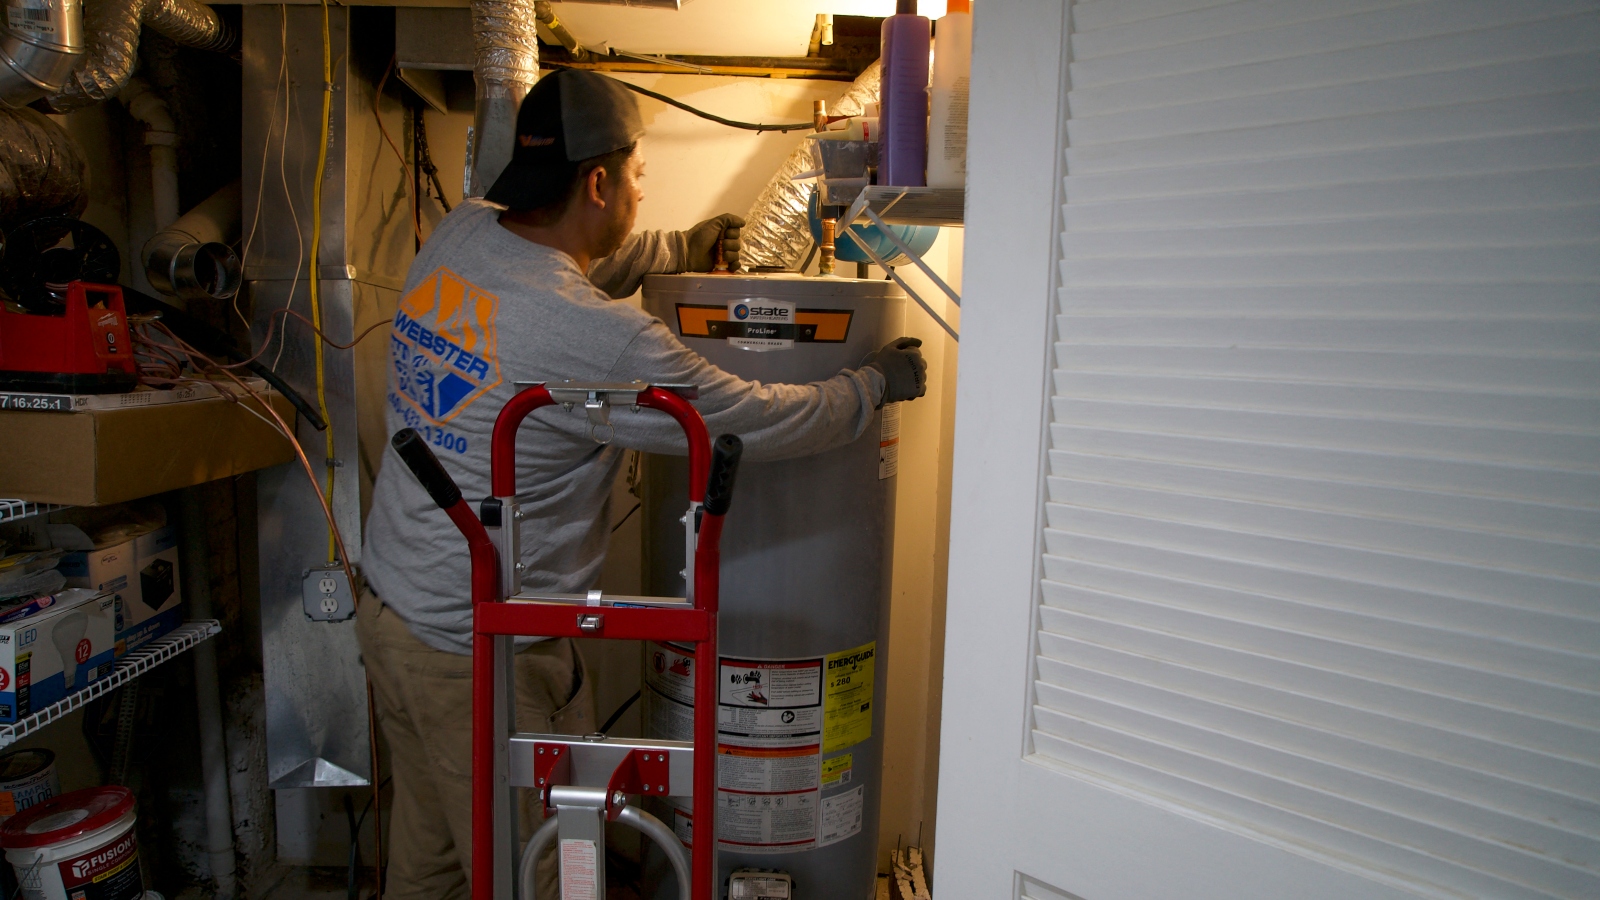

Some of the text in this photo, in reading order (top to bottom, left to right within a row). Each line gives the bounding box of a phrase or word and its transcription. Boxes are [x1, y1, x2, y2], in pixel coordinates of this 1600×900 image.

[750, 306, 789, 317] state
[747, 327, 775, 335] ProLine
[394, 309, 490, 381] WEBSTER
[12, 396, 62, 410] 16x25x1
[75, 397, 89, 407] HDX
[19, 628, 37, 647] LED
[77, 644, 89, 659] 12
[827, 649, 875, 670] ENERGYGUIDE
[13, 779, 50, 800] SAMPLE
[90, 837, 131, 867] FUSION
[87, 862, 110, 876] SINGLE
